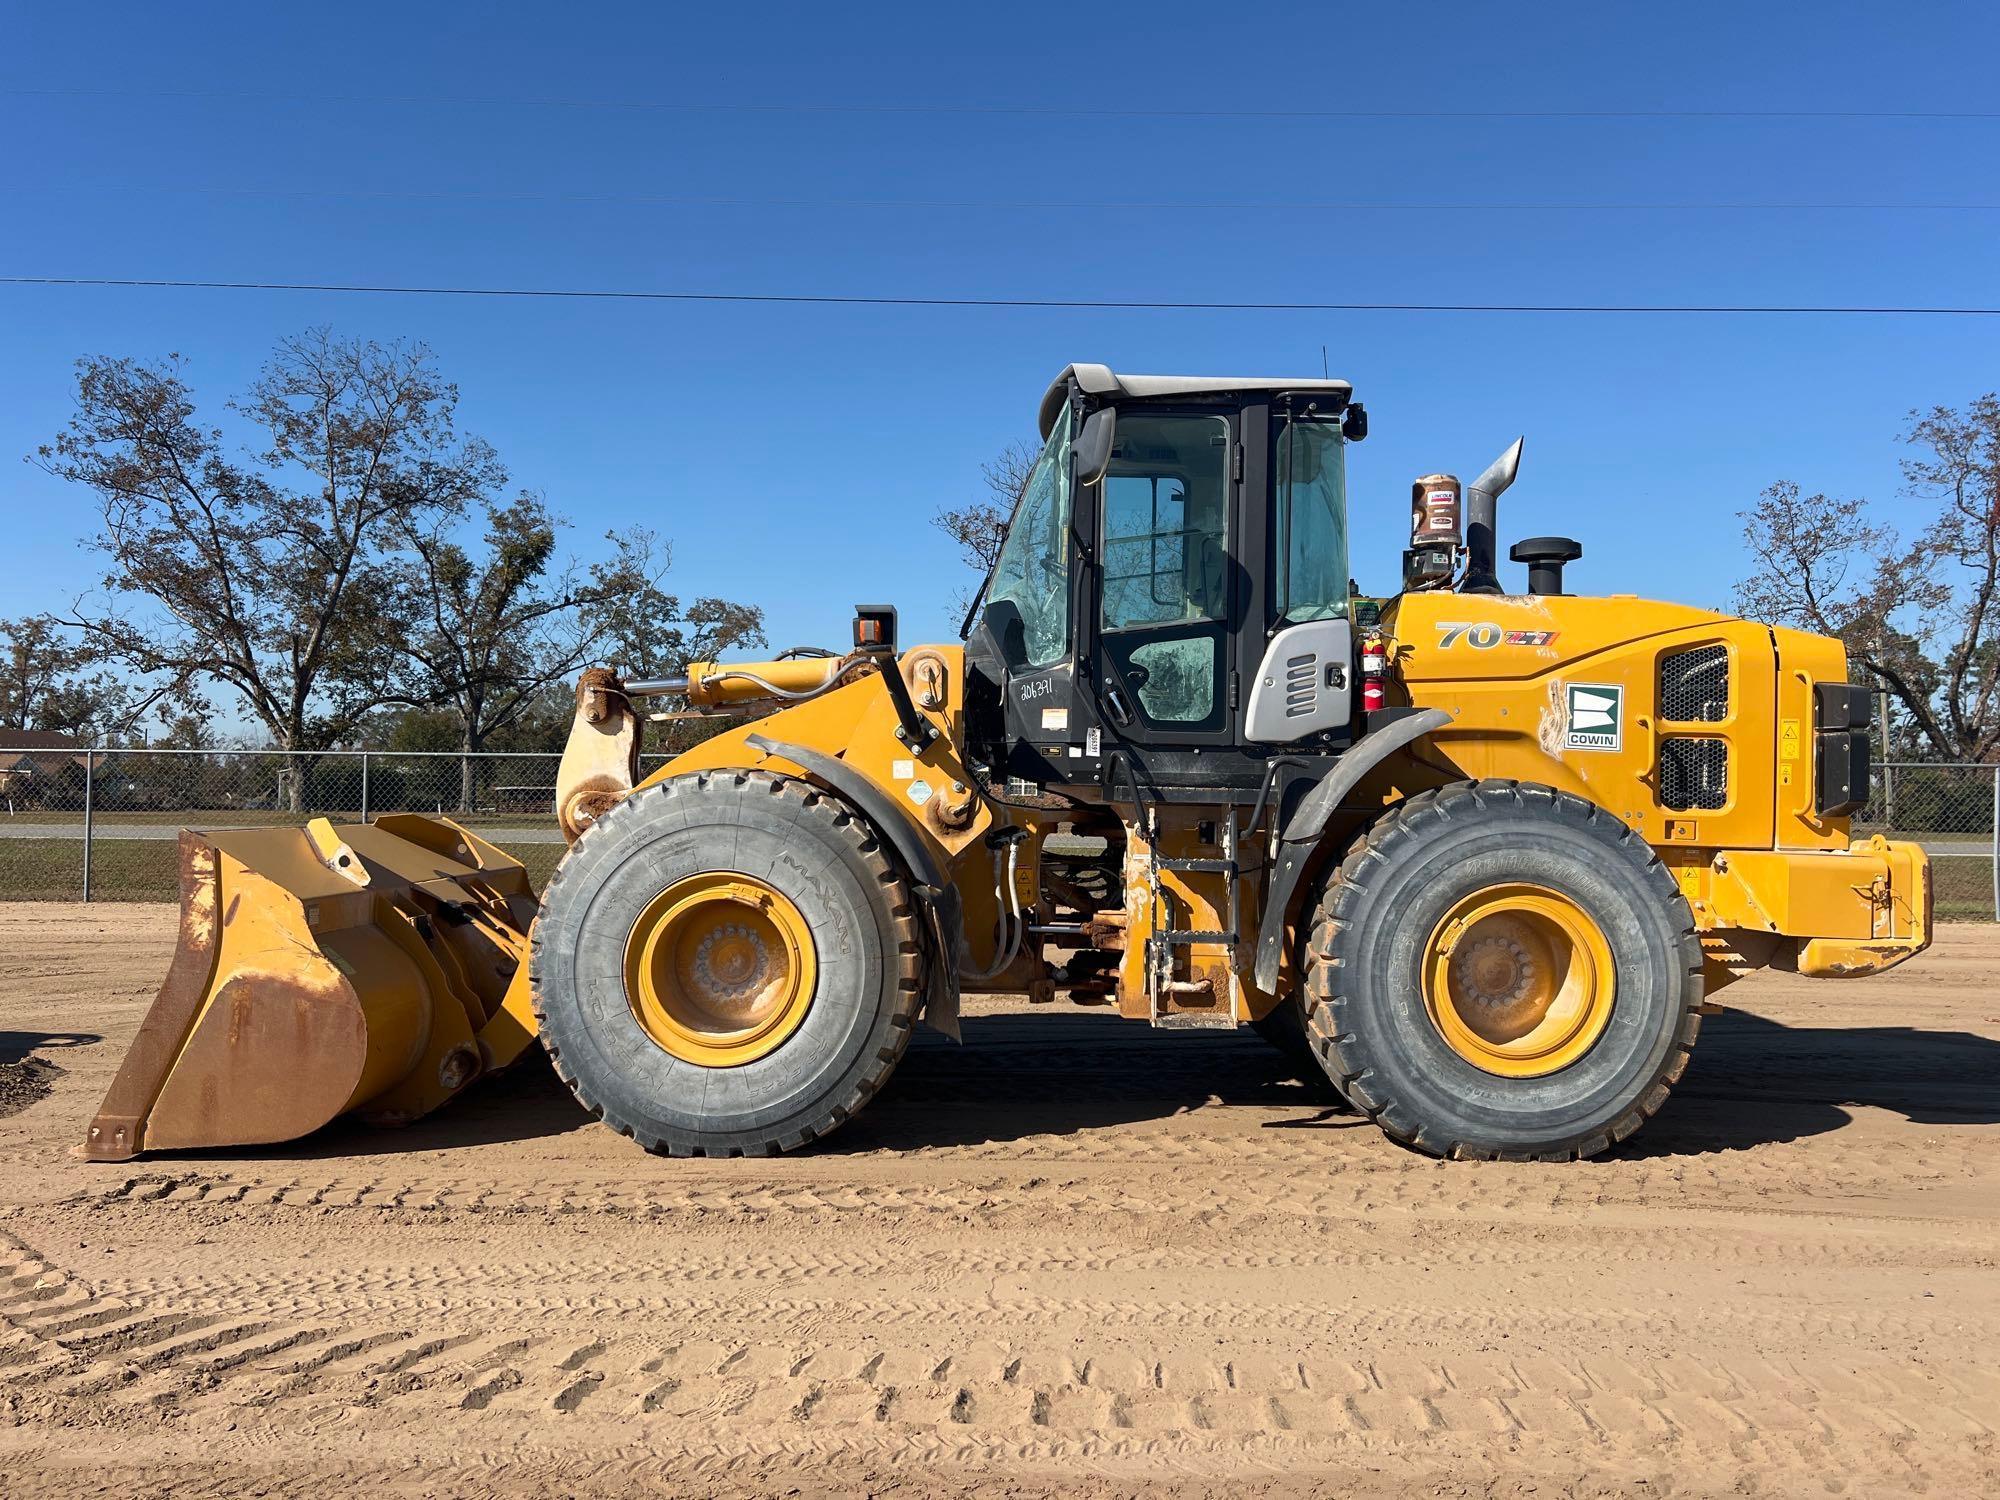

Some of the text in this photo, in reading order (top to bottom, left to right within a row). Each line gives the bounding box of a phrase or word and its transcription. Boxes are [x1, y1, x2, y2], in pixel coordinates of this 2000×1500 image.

[1435, 621, 1502, 650] 70
[1021, 677, 1053, 701] 206391
[1570, 734, 1614, 746] COWIN
